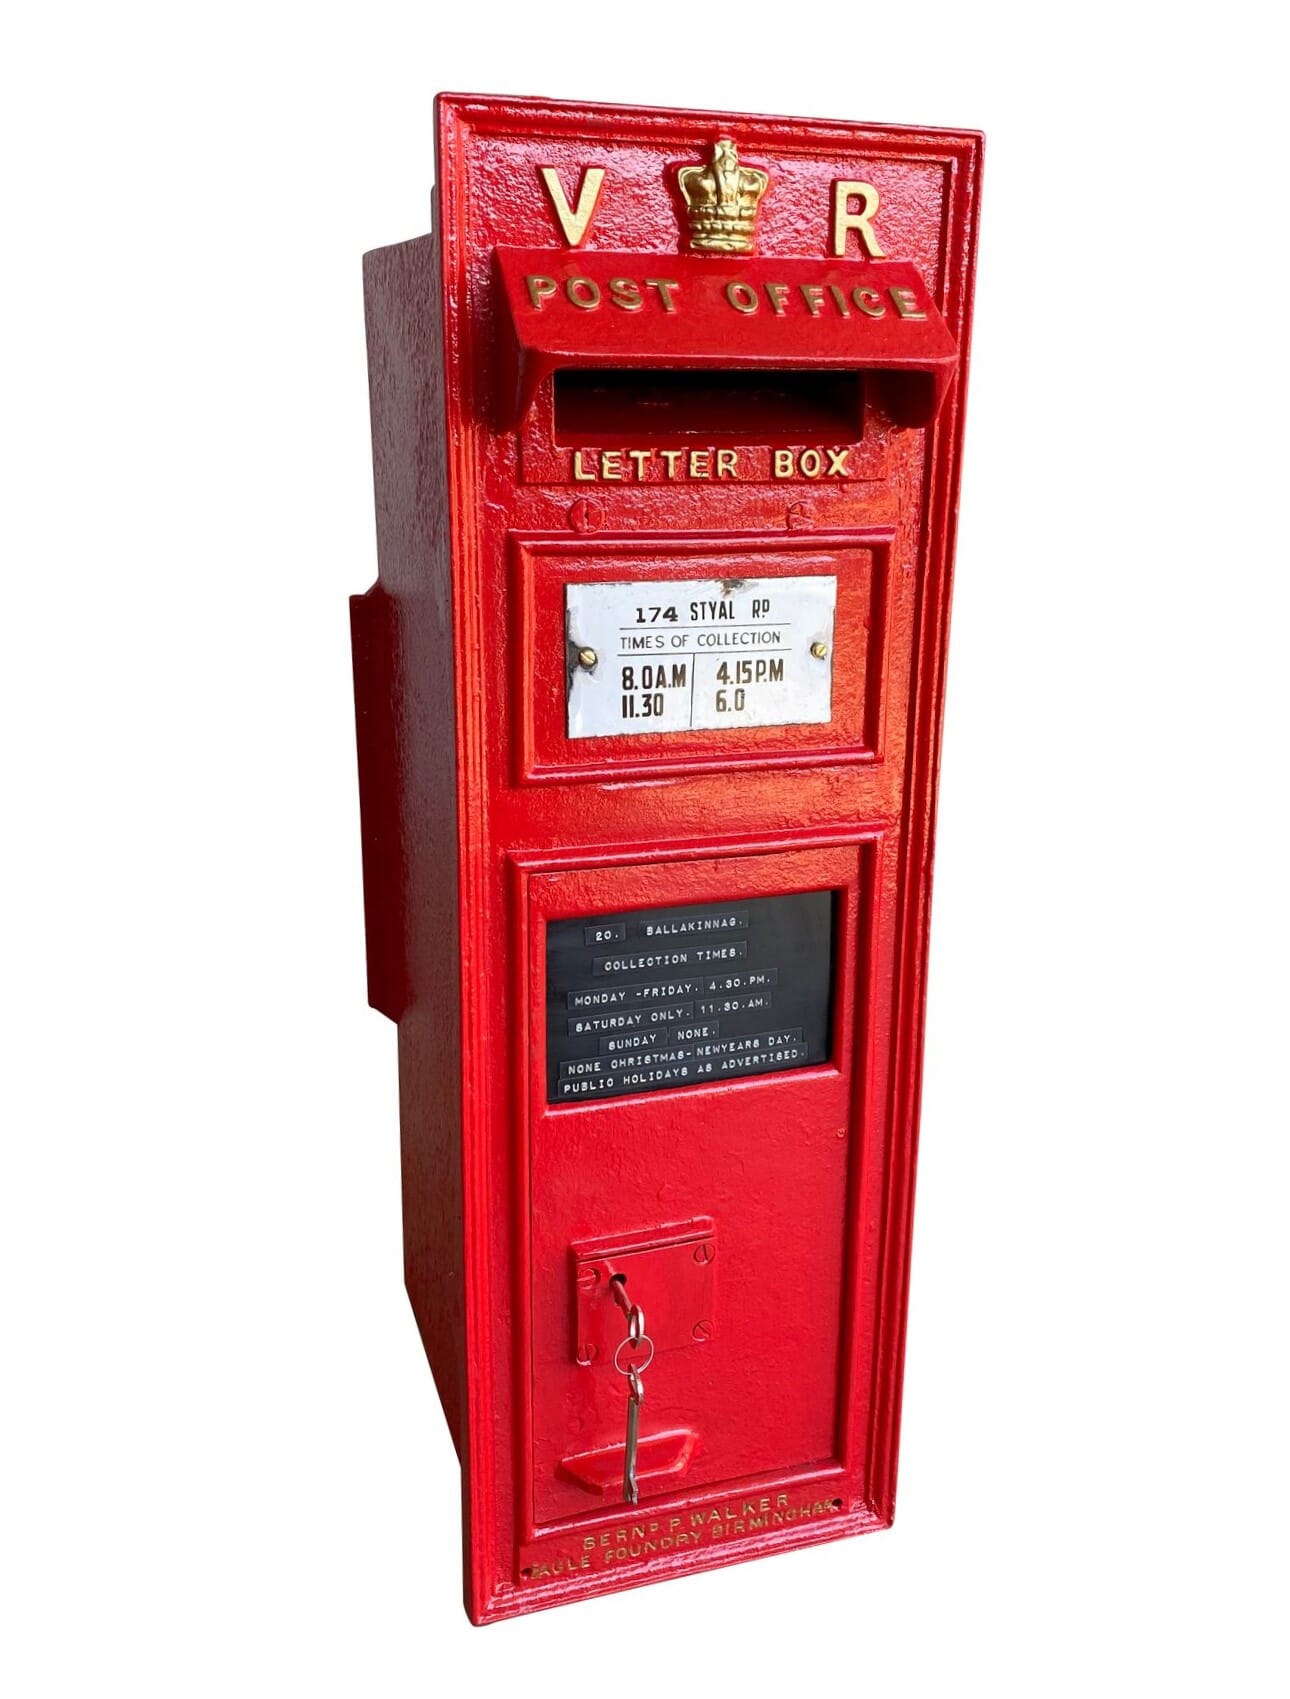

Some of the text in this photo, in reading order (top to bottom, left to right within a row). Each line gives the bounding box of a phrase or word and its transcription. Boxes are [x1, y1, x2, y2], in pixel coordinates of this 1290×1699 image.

[540, 166, 885, 259] V R
[523, 274, 928, 321] POST OFFICE
[572, 448, 850, 481] LETTER BOX
[635, 606, 679, 623] 174
[689, 600, 736, 621] STYAL
[619, 630, 781, 650] TIMES OF COLLECTION
[621, 693, 665, 719] 11.30
[715, 688, 746, 713] 6.0
[594, 916, 744, 942] 20. BALLAKINNAG.
[603, 947, 744, 972] COLLECTION TIMES.
[574, 991, 627, 1006] MONDAY
[574, 1014, 643, 1033] SATURDAY
[651, 1009, 691, 1022] ONLY.
[608, 1028, 717, 1051] SUNDAY NONE.
[567, 1061, 602, 1076] NONE
[768, 1034, 798, 1047] DAY.
[563, 1049, 806, 1095] PUBLIC HOLIDAYS AS ADVERTISED.
[669, 1518, 683, 1532] P
[690, 1494, 790, 1528] WALKER
[605, 1531, 702, 1563] FOUNDRY
